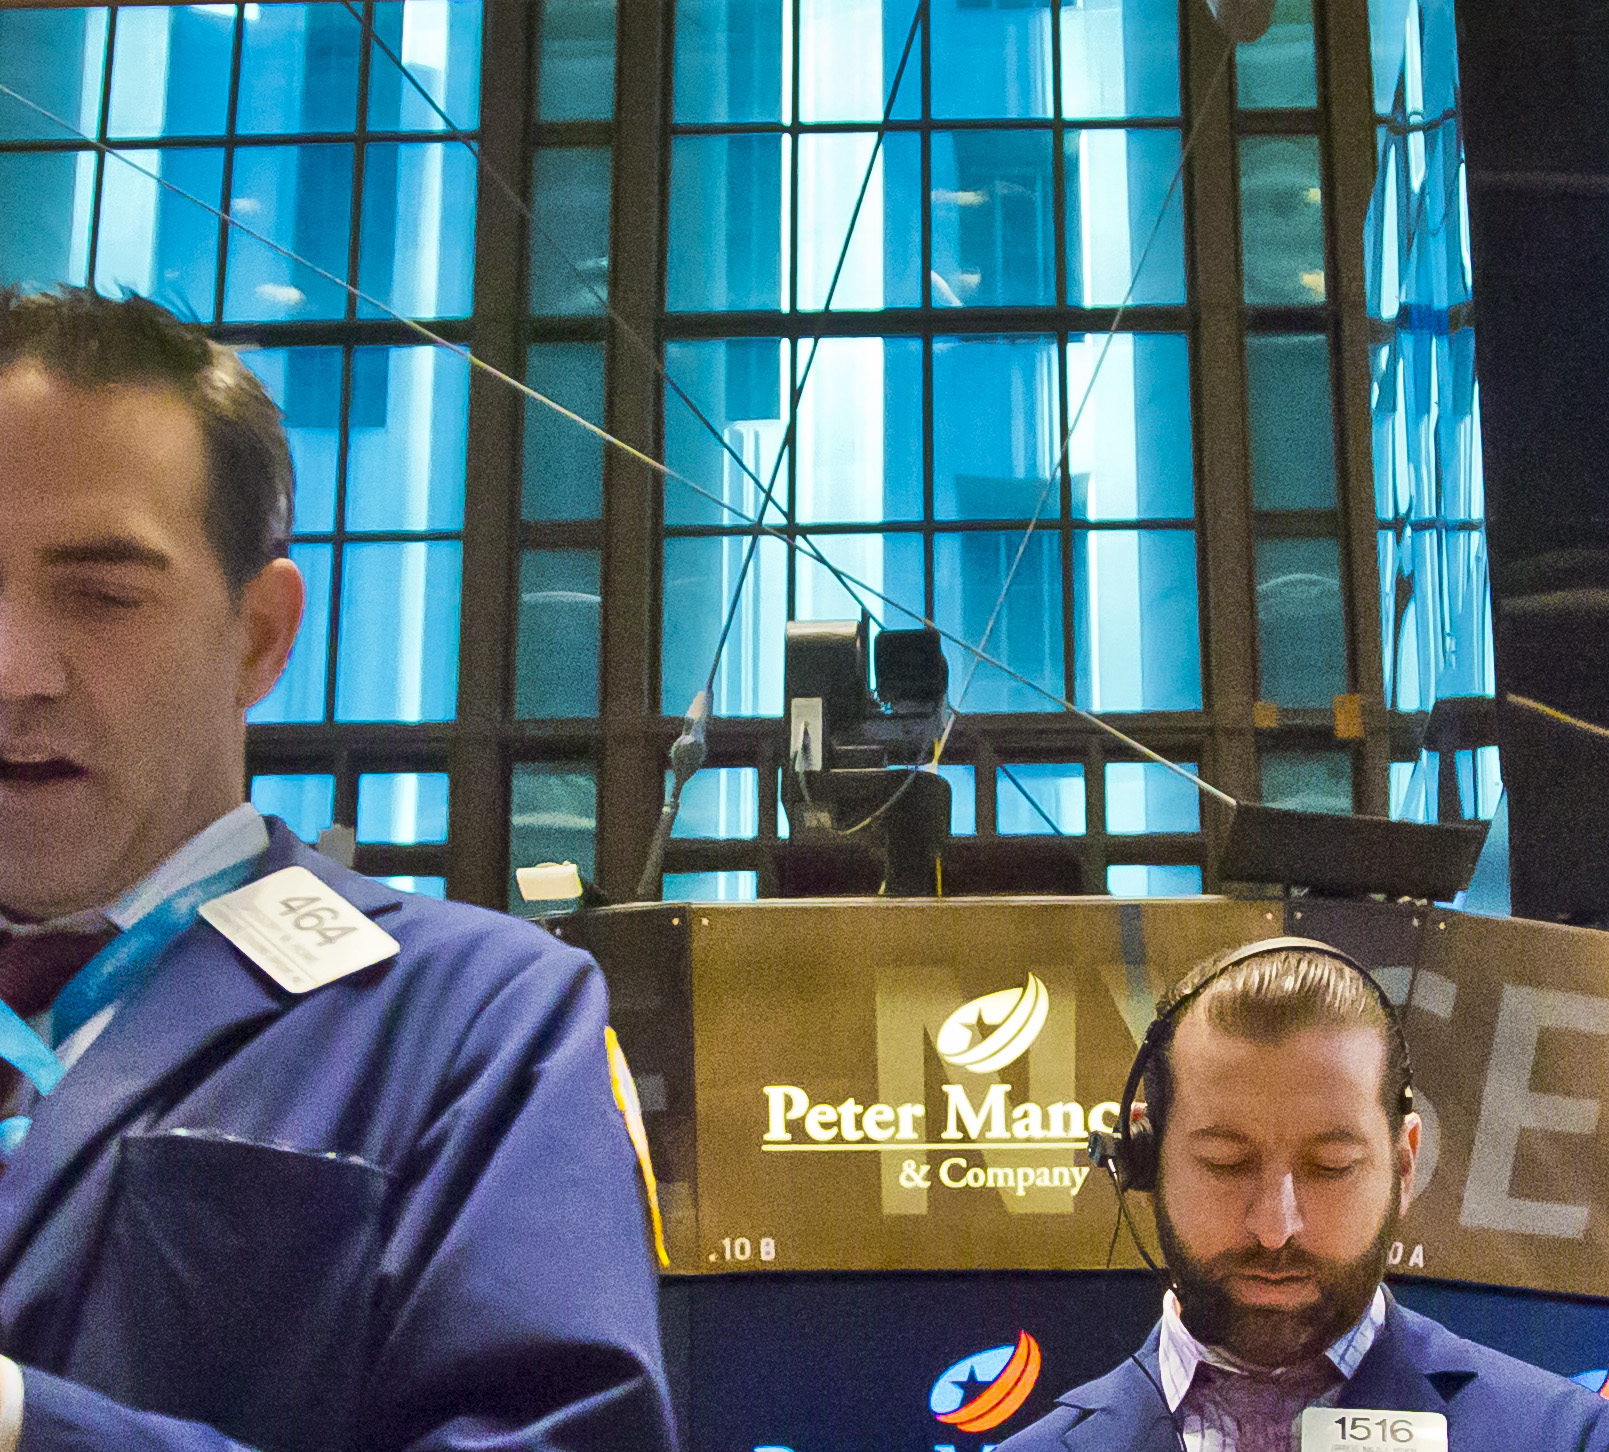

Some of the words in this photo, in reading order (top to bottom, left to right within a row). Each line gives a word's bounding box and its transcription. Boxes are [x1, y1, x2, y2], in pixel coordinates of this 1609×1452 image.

[279, 896, 359, 946] 464
[762, 1085, 925, 1141] Peter
[941, 1084, 1121, 1139] Manc
[899, 1160, 931, 1188] &
[939, 1157, 1089, 1196] Company
[722, 1237, 751, 1260] 10
[1409, 1244, 1424, 1268] A
[1335, 1416, 1414, 1443] 1516
